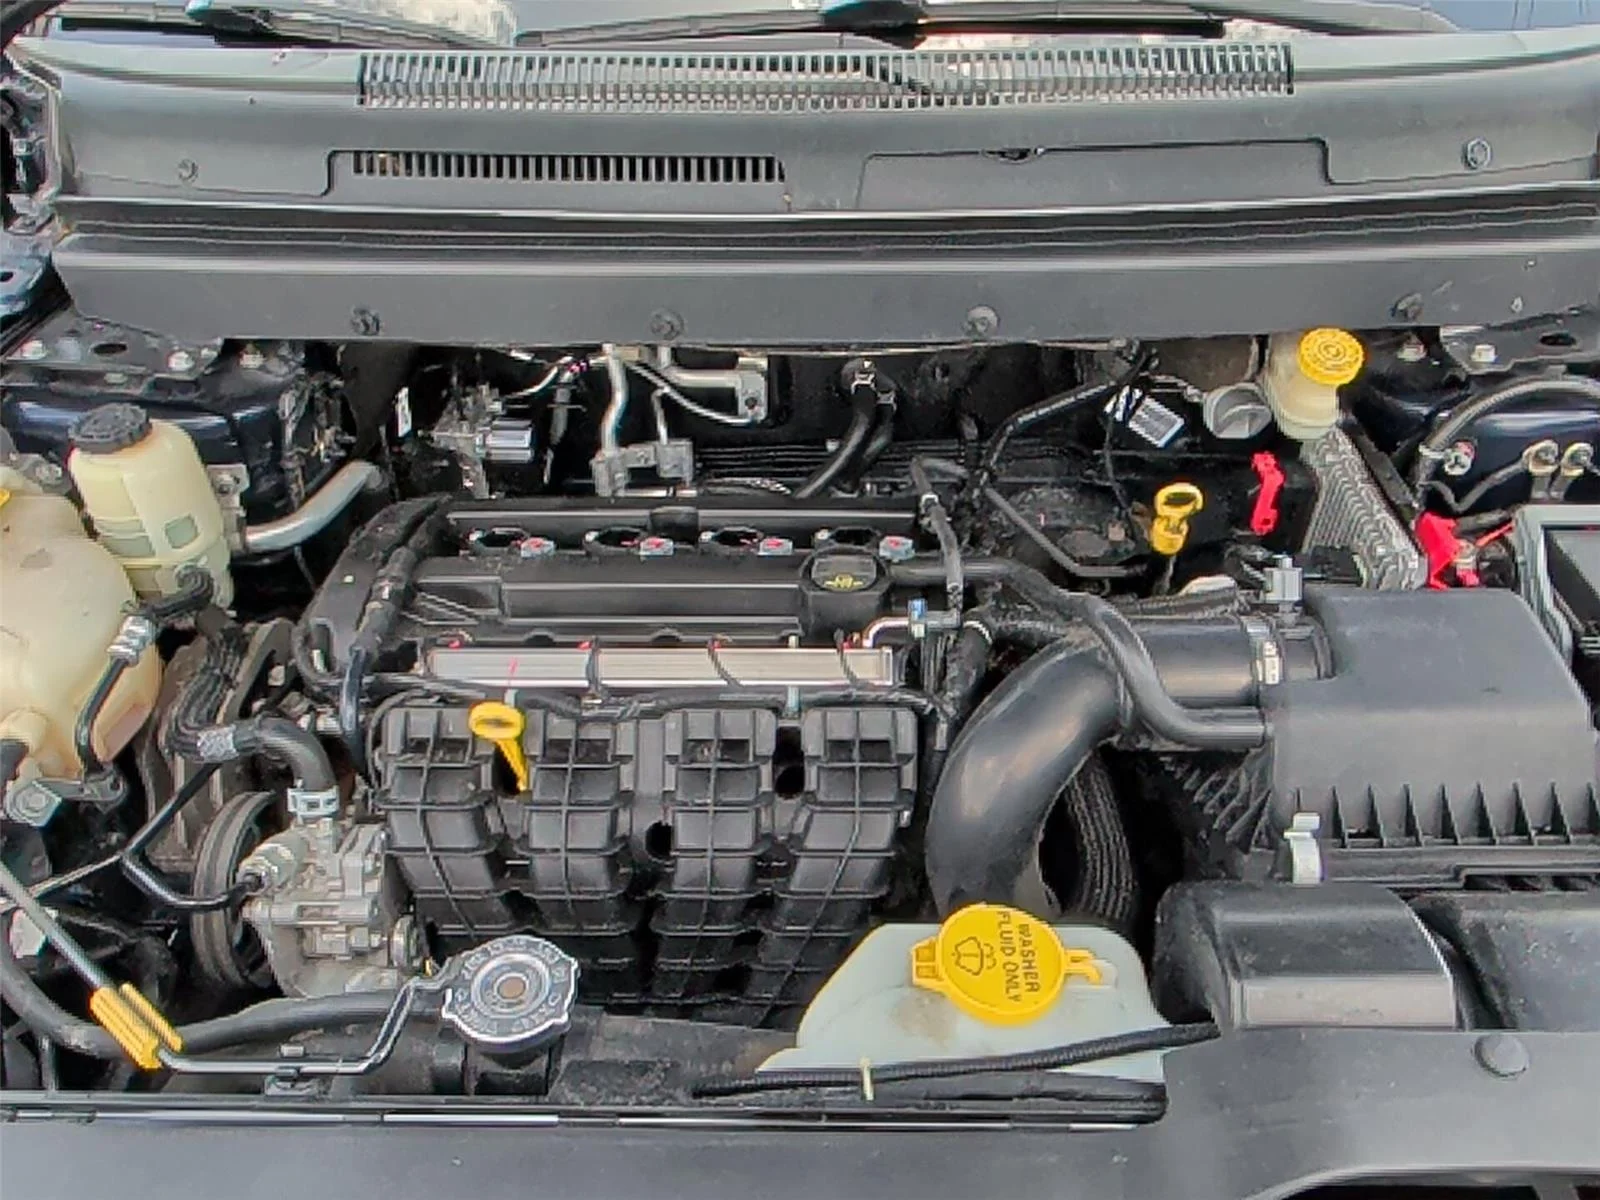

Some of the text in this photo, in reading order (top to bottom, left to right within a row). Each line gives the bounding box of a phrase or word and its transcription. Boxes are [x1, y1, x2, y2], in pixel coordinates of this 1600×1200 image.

[998, 911, 1021, 1002] FLUID ONLY
[1019, 924, 1040, 992] WASHER
